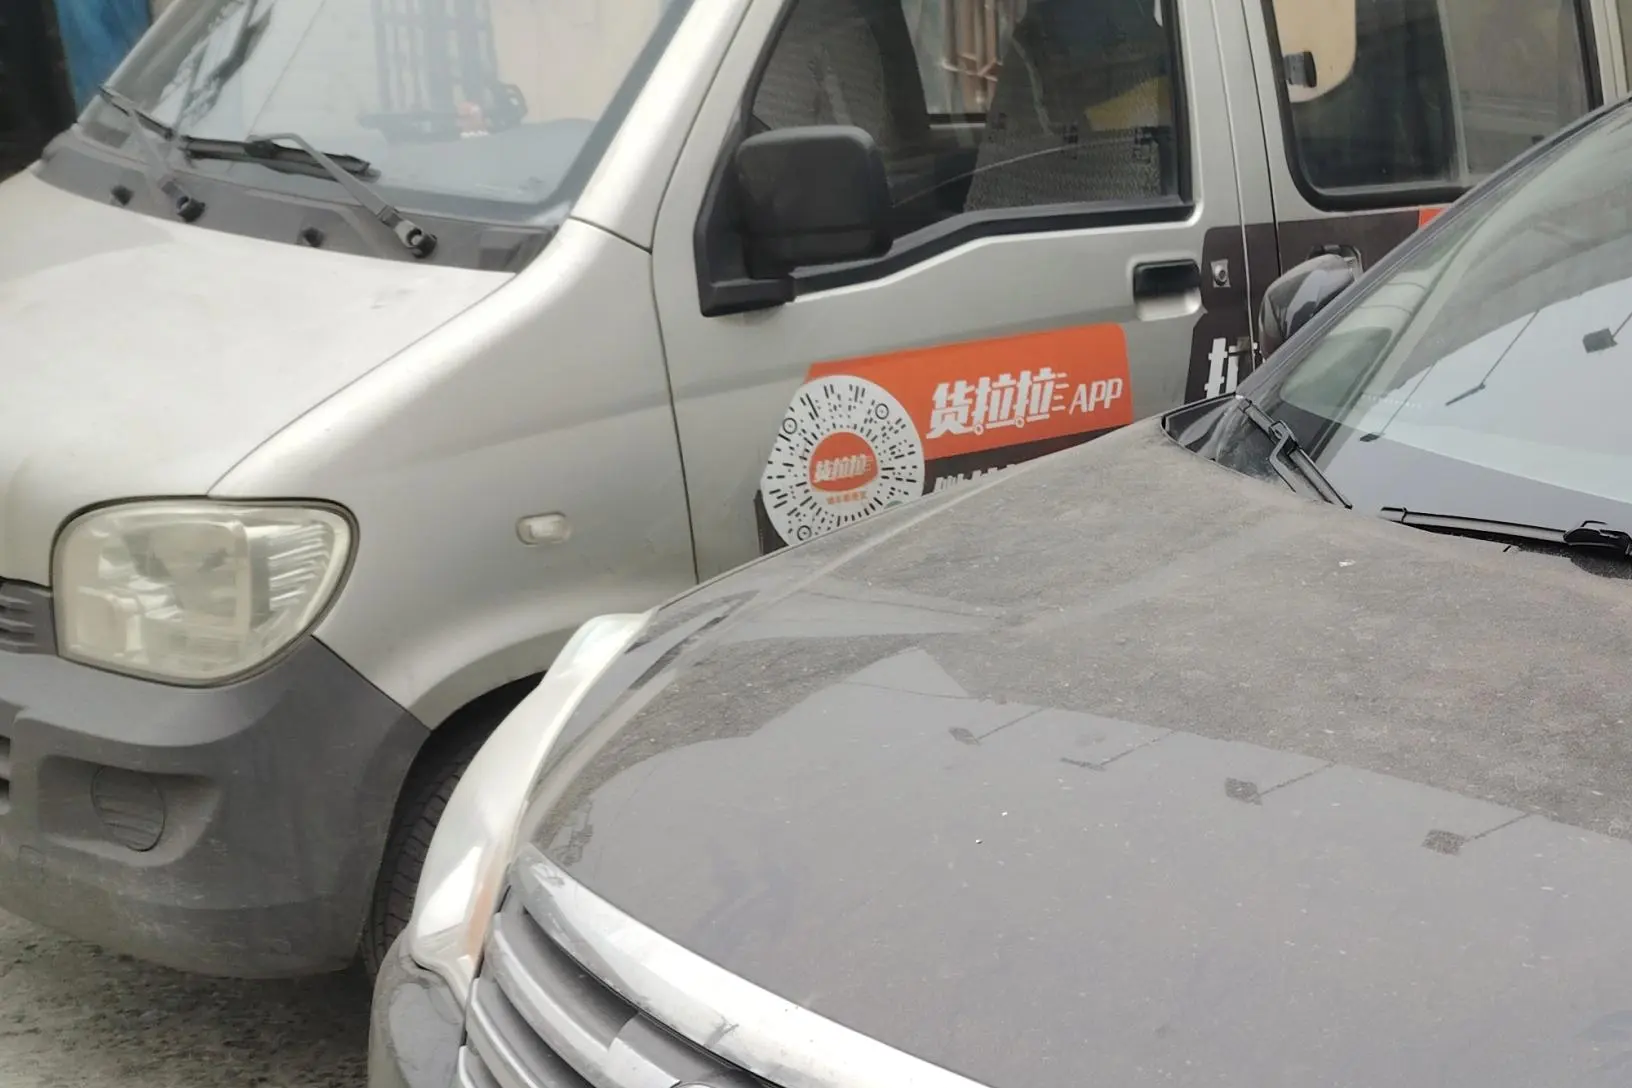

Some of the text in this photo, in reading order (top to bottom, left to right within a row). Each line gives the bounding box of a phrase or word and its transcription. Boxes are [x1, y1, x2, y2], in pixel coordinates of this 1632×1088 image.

[926, 367, 1123, 440] 货拉拉 APP
